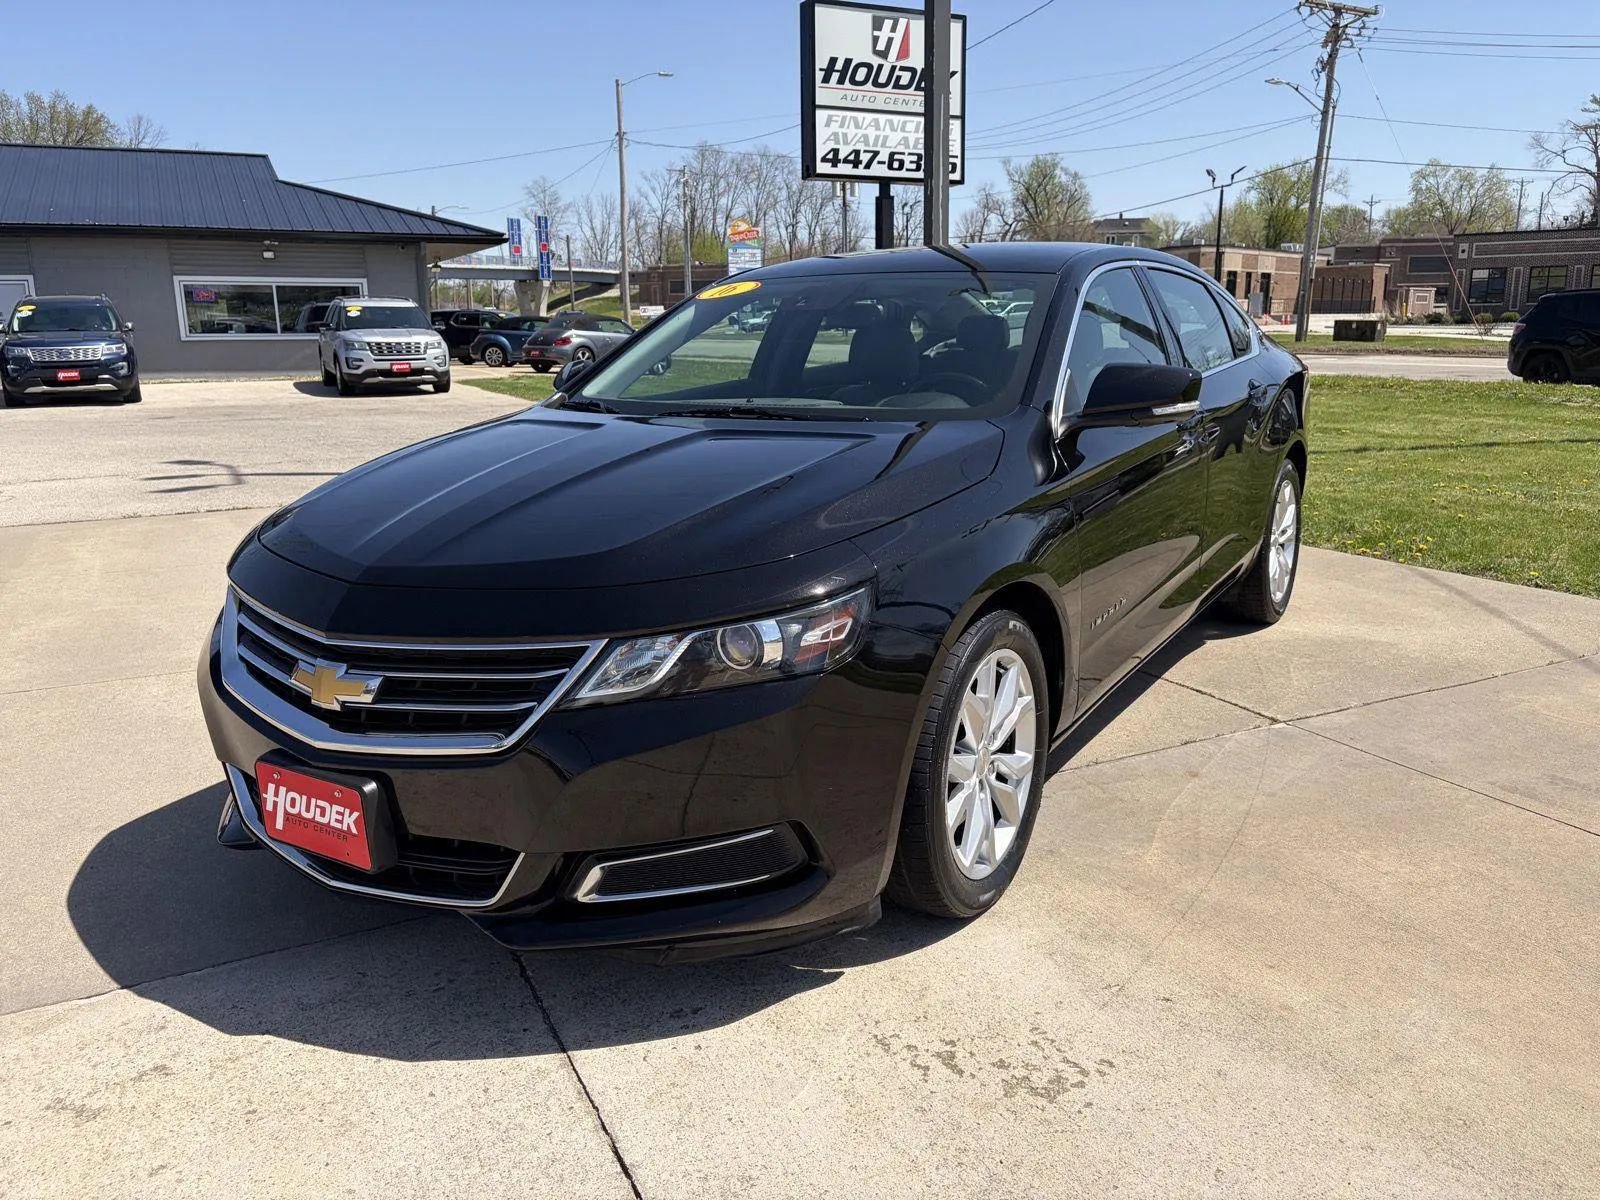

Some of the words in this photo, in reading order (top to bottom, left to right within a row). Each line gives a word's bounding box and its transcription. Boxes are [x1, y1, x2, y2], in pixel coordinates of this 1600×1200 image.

[819, 56, 959, 91] HOUD
[840, 93, 876, 104] AUTO
[884, 97, 925, 108] CENTE
[824, 114, 954, 136] FINANCI
[822, 131, 957, 153] AVAILAB
[820, 148, 958, 174] 447-63
[262, 783, 360, 835] HOUDEK
[284, 817, 309, 830] AUTO
[313, 826, 348, 842] CENTER
